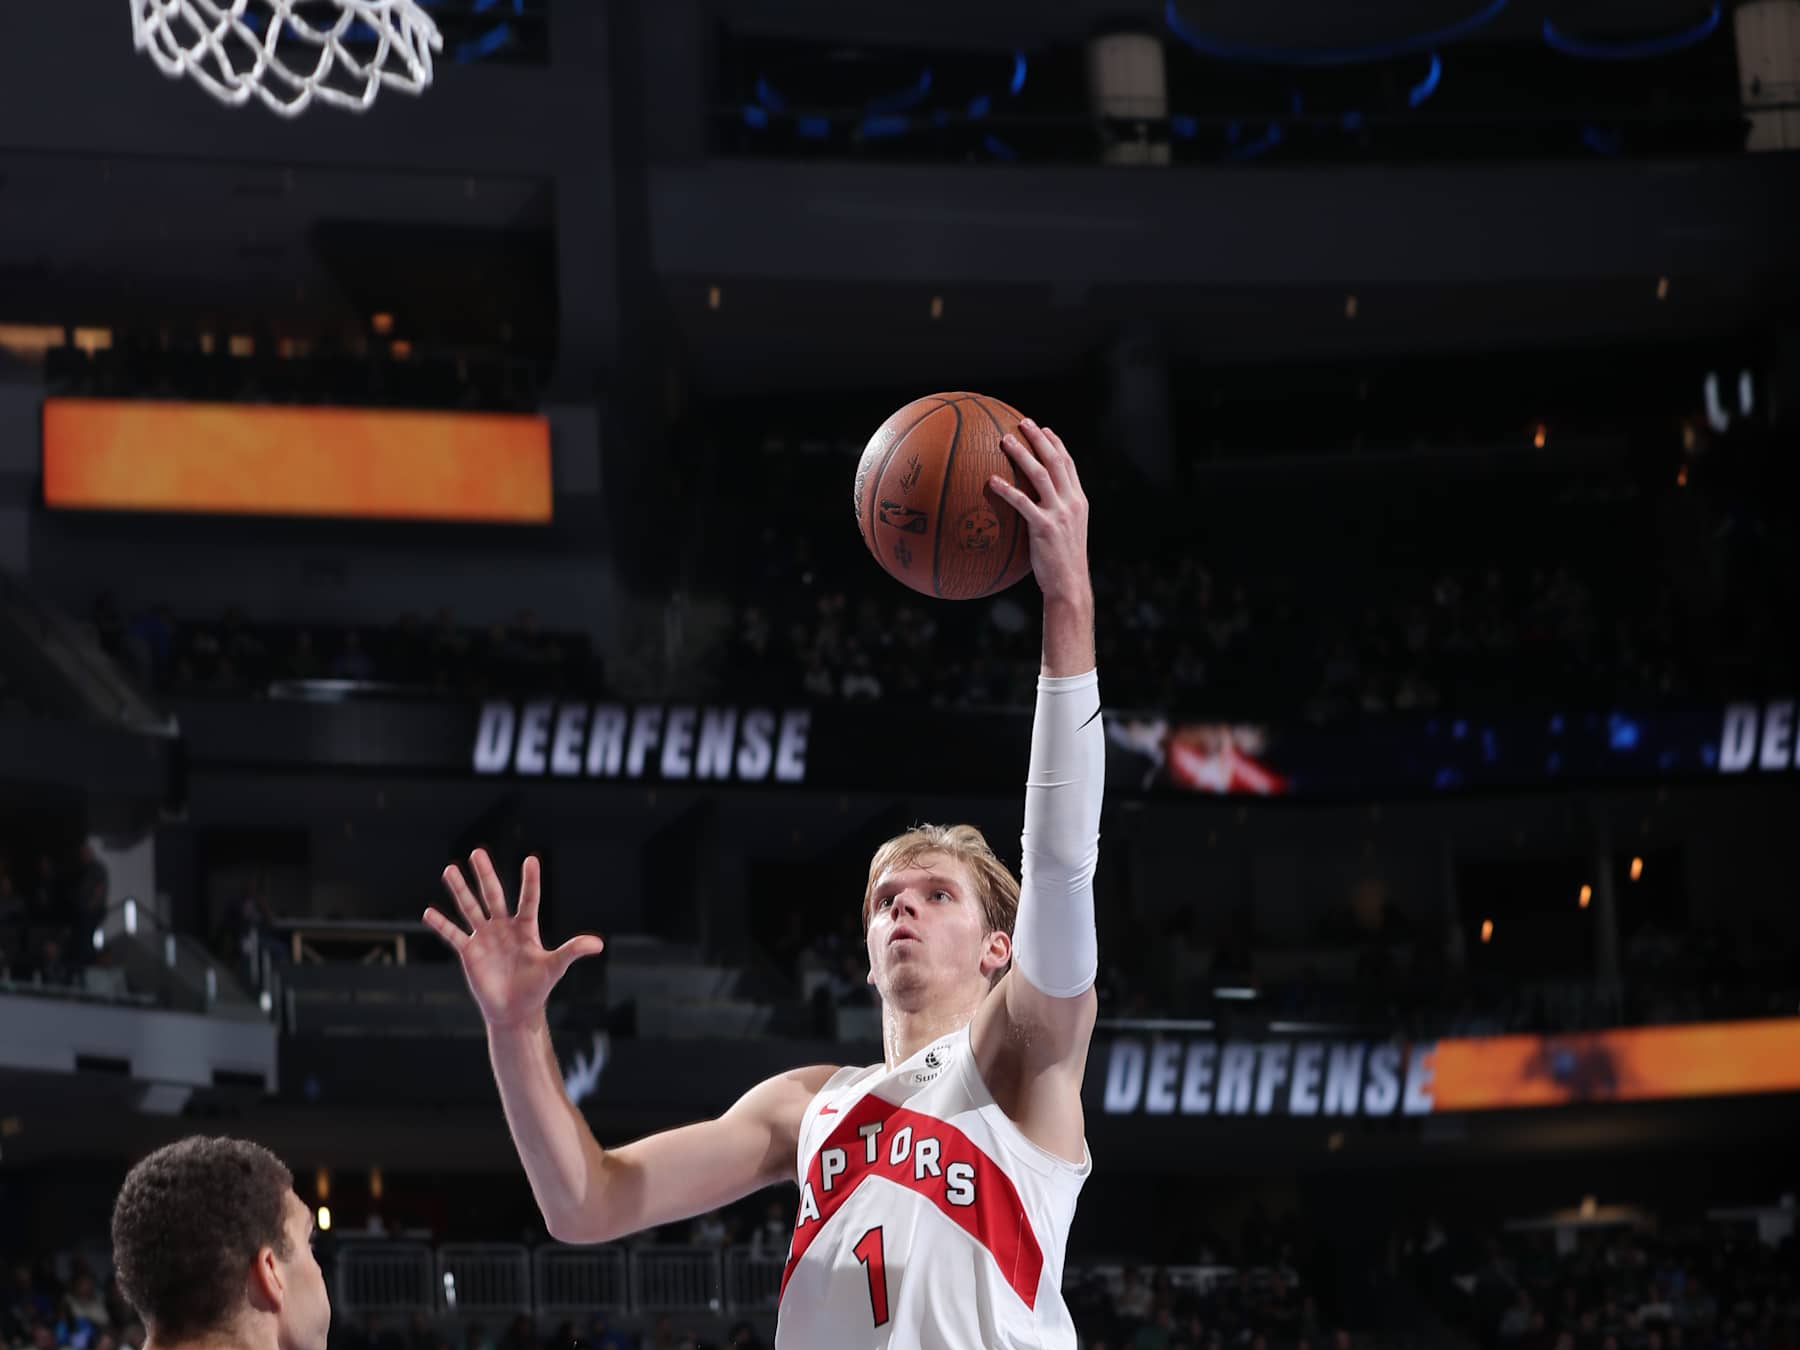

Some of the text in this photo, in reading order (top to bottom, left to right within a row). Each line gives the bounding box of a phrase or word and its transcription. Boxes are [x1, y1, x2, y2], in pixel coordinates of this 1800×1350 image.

[474, 702, 811, 780] DEERFENSE
[1719, 702, 1800, 773] DE
[1104, 1040, 1436, 1115] DEERFENSE
[786, 1121, 976, 1262] APTORS
[853, 1225, 889, 1328] 1
